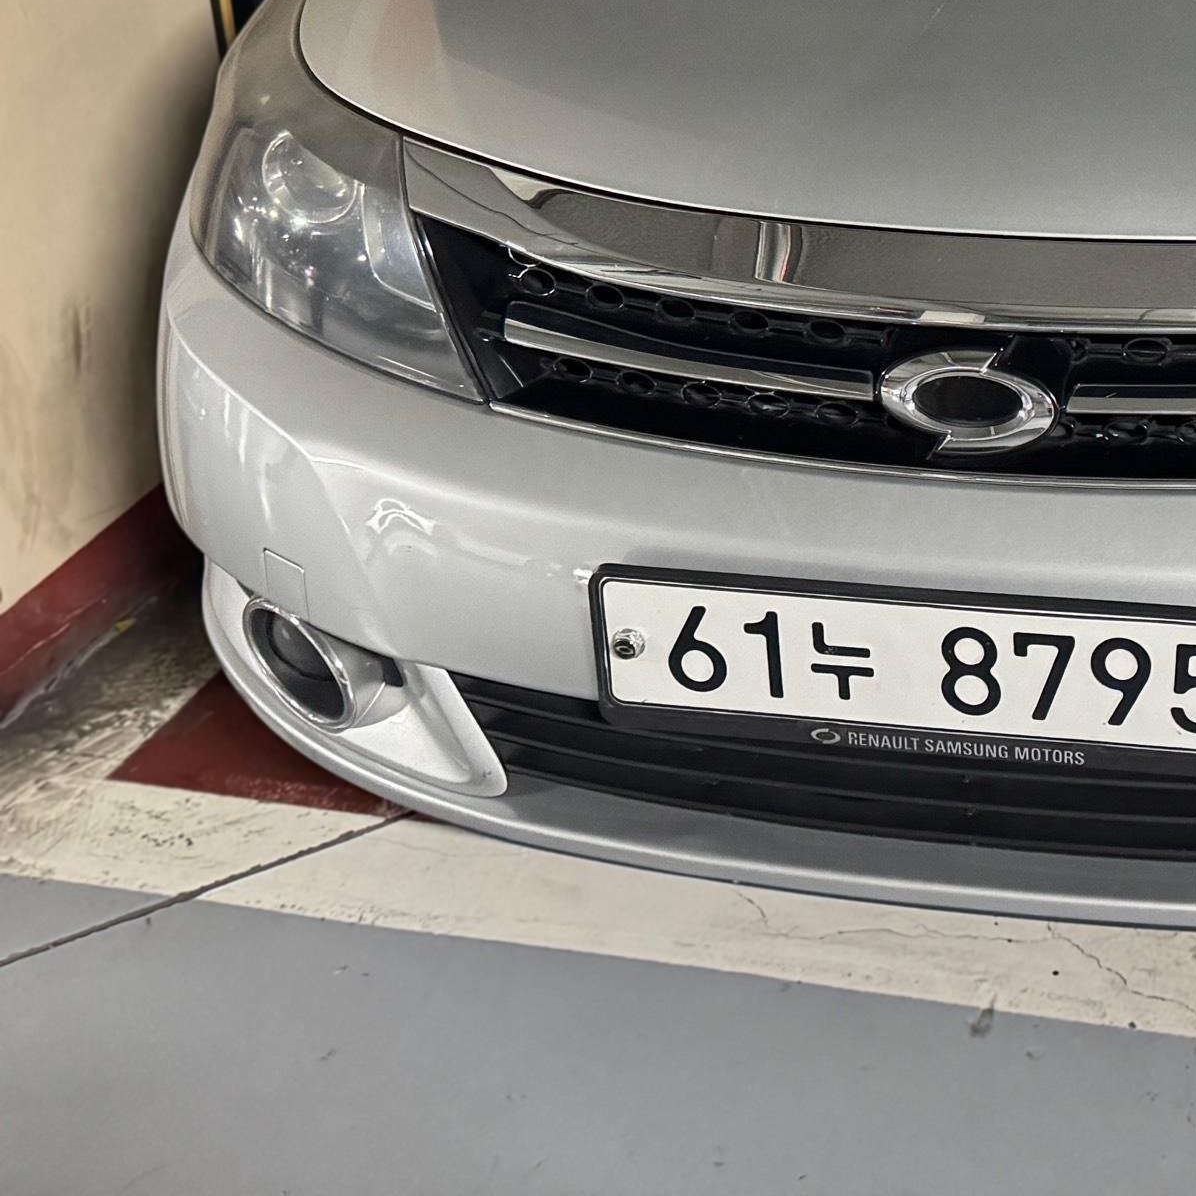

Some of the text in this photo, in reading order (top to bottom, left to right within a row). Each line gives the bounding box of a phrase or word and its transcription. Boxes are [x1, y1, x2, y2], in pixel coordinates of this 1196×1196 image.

[667, 606, 875, 700] 61누
[848, 731, 1086, 766] RENAULT SAMSUNG MOTORS
